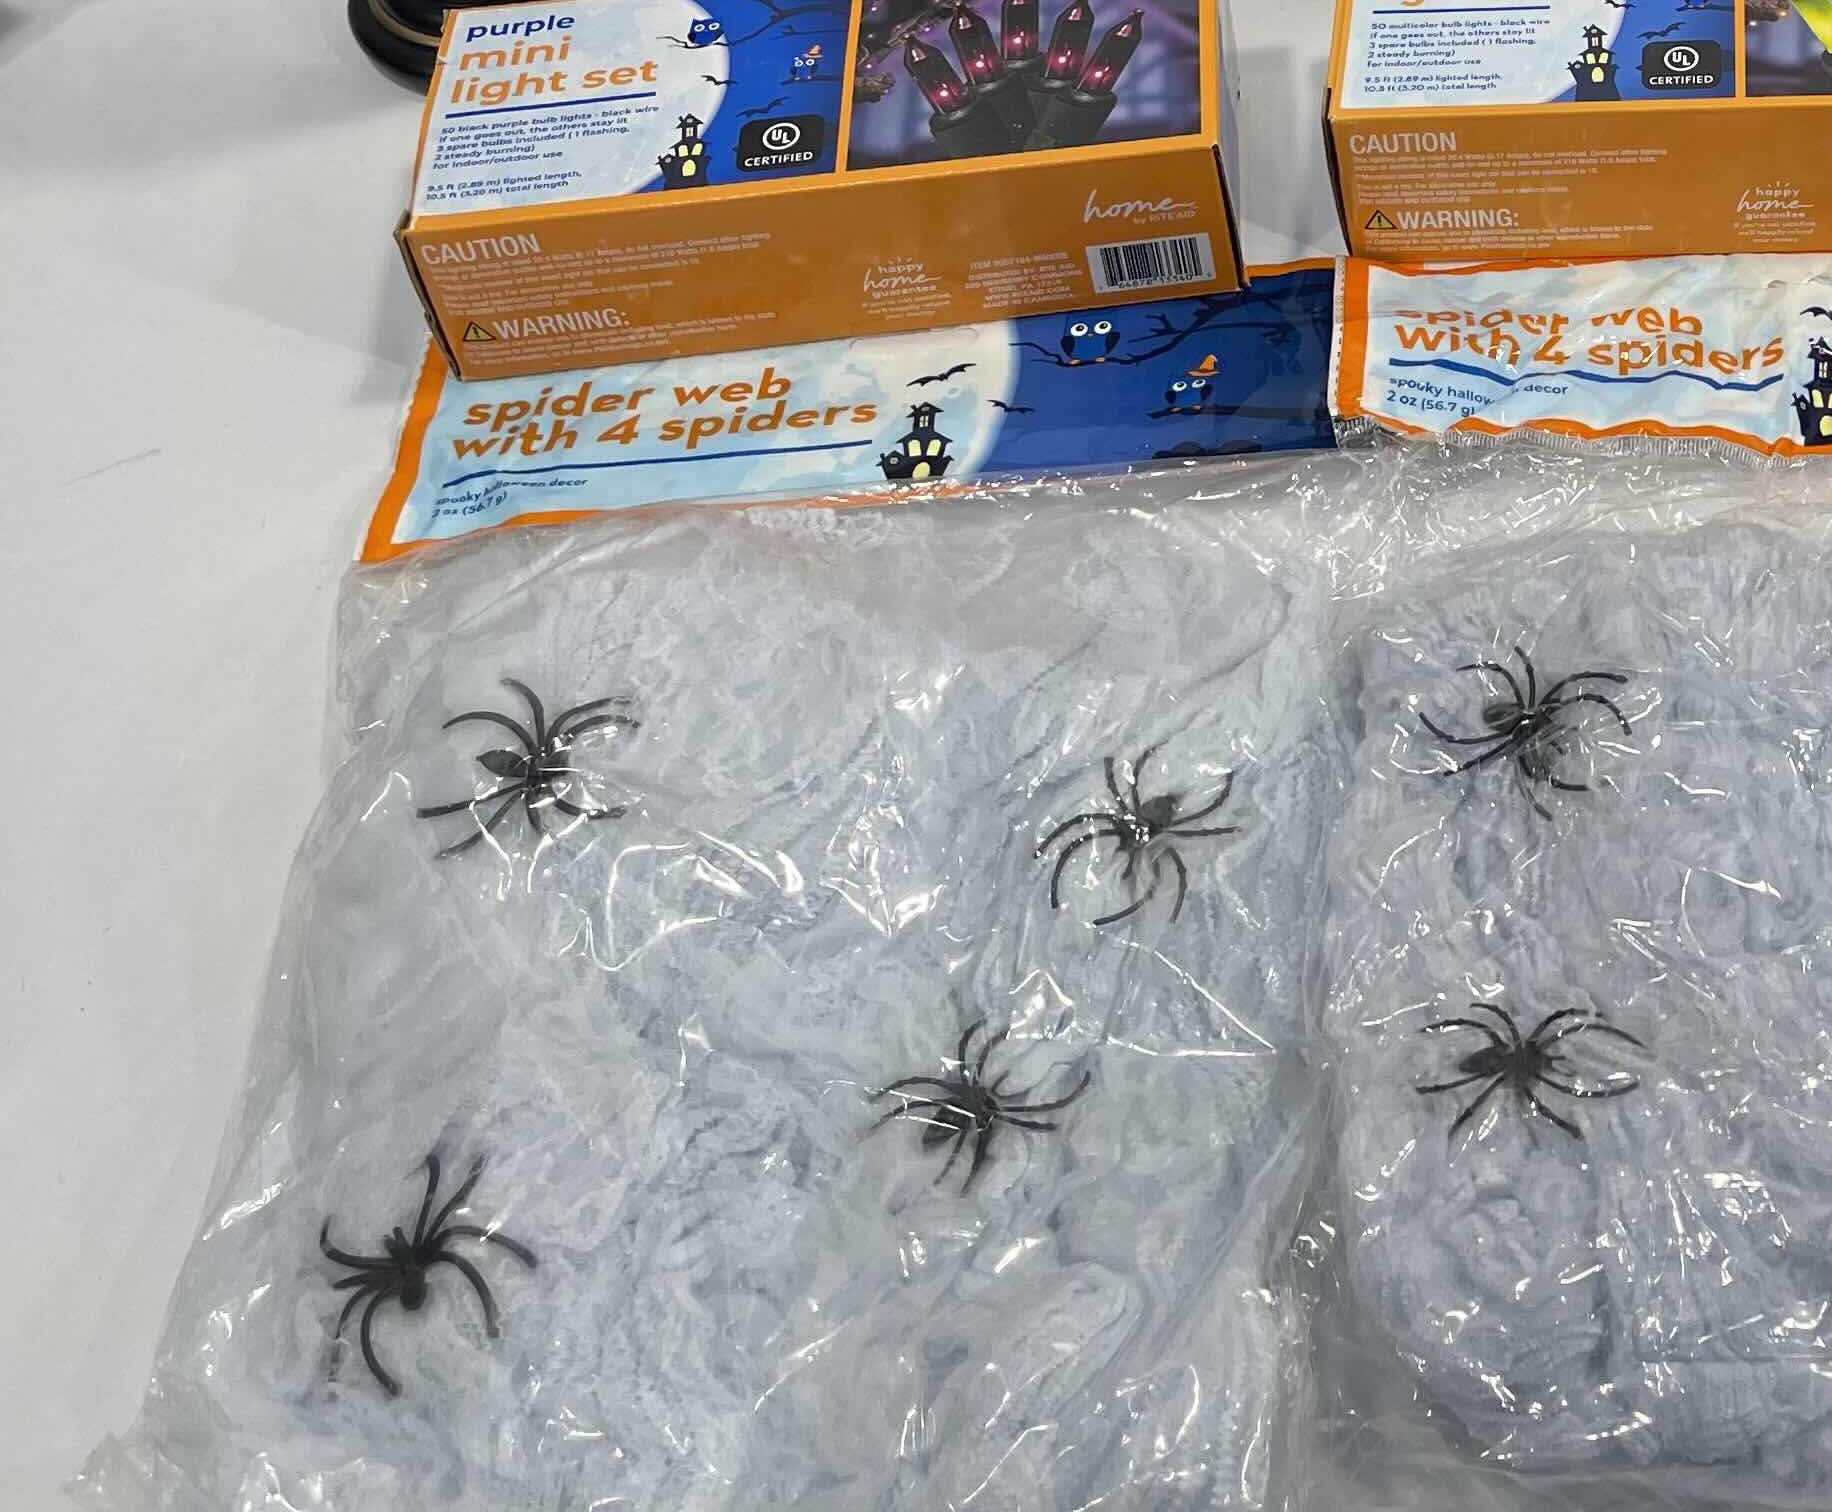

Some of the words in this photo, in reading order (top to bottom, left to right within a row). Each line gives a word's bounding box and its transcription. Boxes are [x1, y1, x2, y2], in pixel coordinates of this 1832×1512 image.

[465, 15, 576, 43] purple
[1371, 22, 1387, 31] 50
[1441, 20, 1463, 29] bulb
[1464, 19, 1493, 30] lights
[1499, 19, 1526, 27] black
[458, 34, 573, 71] mini
[1367, 60, 1384, 69] for
[1384, 58, 1462, 68] indoor/outdoor
[1377, 50, 1411, 60] steady
[450, 71, 568, 106] light
[581, 59, 659, 89] set
[1649, 74, 1714, 86] CERTIFIED
[440, 126, 456, 136] 50
[457, 122, 489, 134] black
[490, 119, 529, 133] purple
[531, 116, 559, 126] bulb
[560, 112, 593, 125] lights
[600, 107, 632, 119] black
[635, 104, 660, 114] wire
[449, 134, 473, 144] one
[474, 131, 505, 143] goes
[529, 125, 550, 135] the
[551, 121, 588, 134] others
[590, 118, 615, 129] stay
[444, 149, 483, 162] steady
[485, 143, 536, 157] burning)
[1350, 131, 1458, 155] CAUTION
[432, 161, 451, 171] for
[452, 152, 540, 170] indoor/outdoor
[542, 149, 564, 159] use
[743, 151, 814, 167] CERTIFIED
[1736, 189, 1815, 213] home
[1755, 186, 1801, 198] happy
[1083, 188, 1200, 224] home
[1745, 212, 1806, 221] guarantee
[1396, 207, 1520, 231] WARNING:
[419, 232, 542, 266] CAUTION
[877, 262, 924, 275] happy
[863, 269, 943, 293] home
[871, 284, 937, 300] guarantee
[491, 306, 631, 340] WARNING:
[1591, 307, 1703, 336] web
[1395, 324, 1520, 368] with
[1533, 334, 1572, 365] 4
[1587, 336, 1783, 376] spiders
[1389, 377, 1443, 397] spooky
[1523, 383, 1569, 395] decor
[464, 381, 656, 434] spider
[672, 367, 792, 408] web
[1386, 390, 1396, 402] 2
[1399, 394, 1418, 407] oz
[1421, 397, 1457, 412] (56.7
[452, 422, 579, 462] with
[595, 414, 641, 446] 4
[656, 400, 879, 449] spiders
[435, 490, 482, 506] spooky
[549, 477, 589, 487] decor
